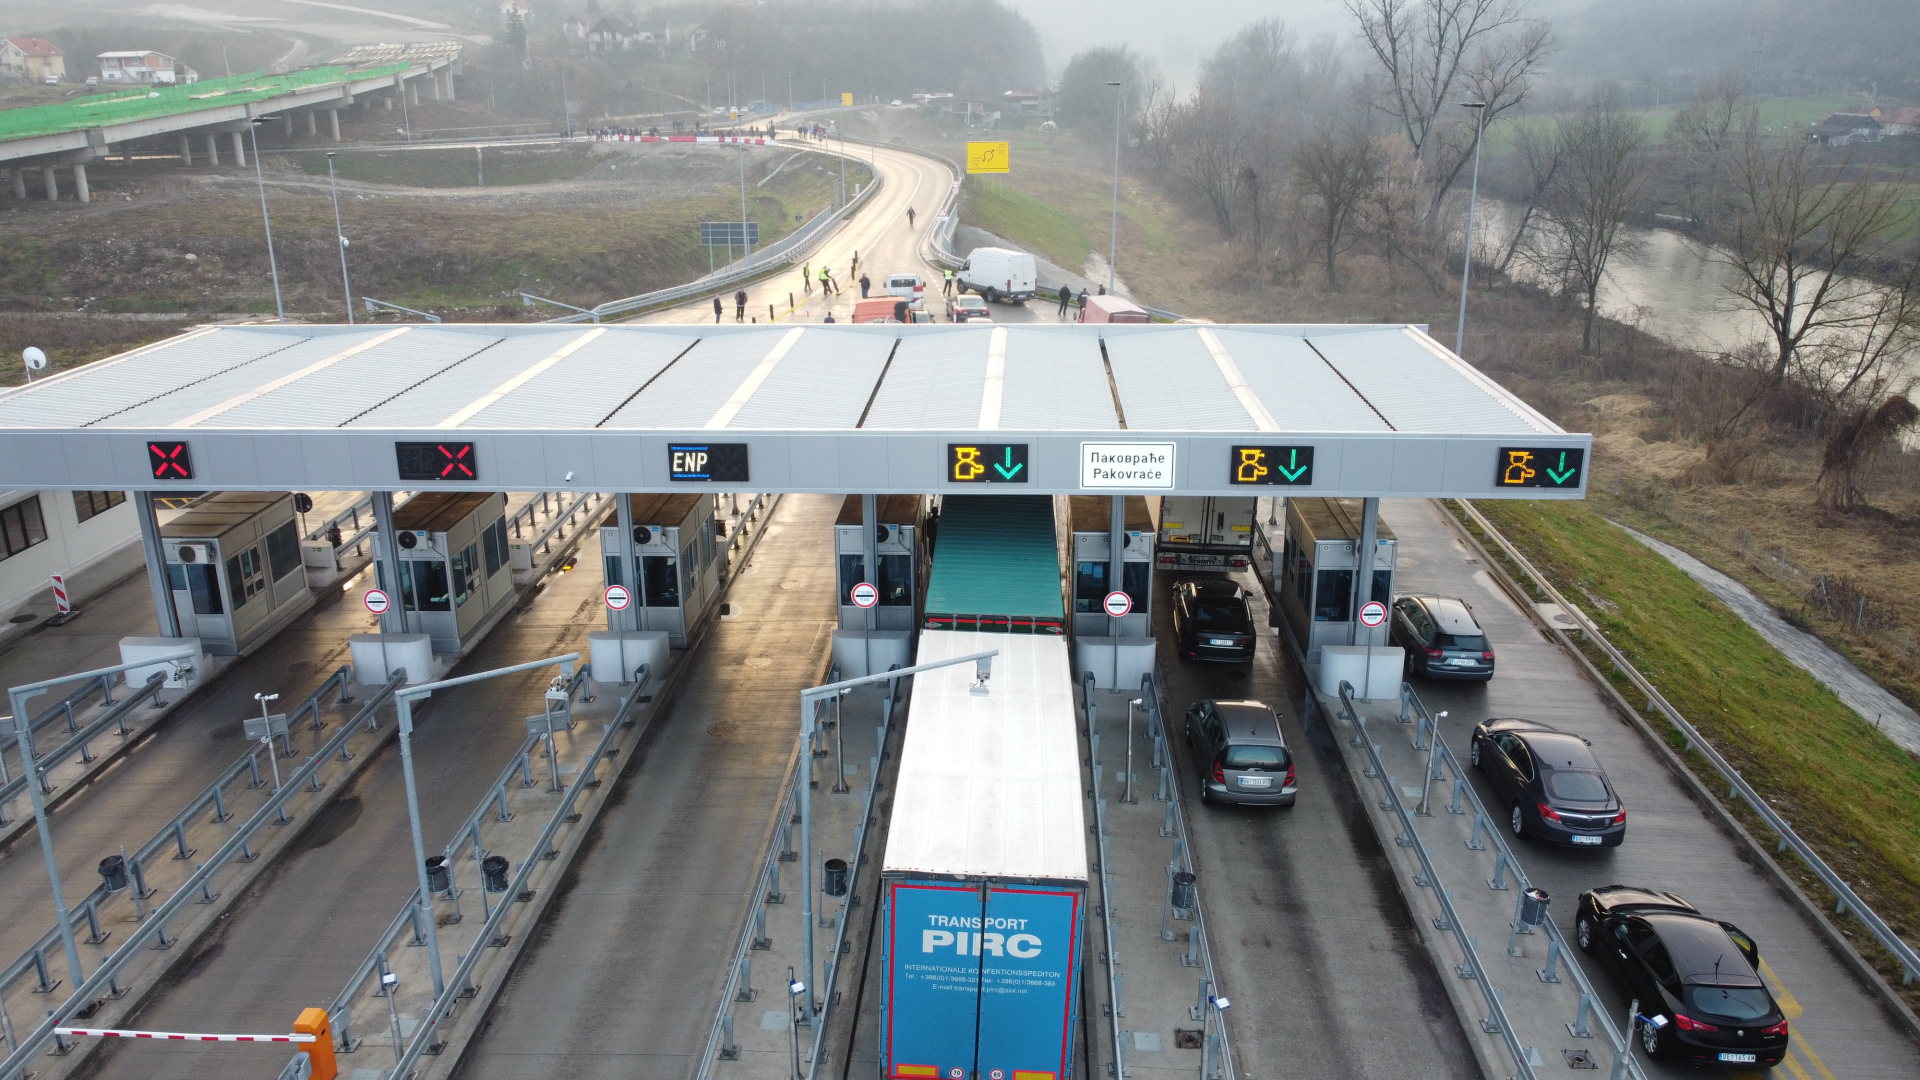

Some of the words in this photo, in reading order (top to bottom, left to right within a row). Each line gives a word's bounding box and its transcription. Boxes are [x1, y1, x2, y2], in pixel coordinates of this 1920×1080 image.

[673, 452, 708, 472] ENP
[1091, 452, 1165, 466] Паковраће
[1093, 467, 1162, 480] Pakovraće
[928, 914, 1028, 930] TRANSPORT
[922, 930, 1042, 958] PIRC
[904, 964, 966, 974] INTERNATIONALE
